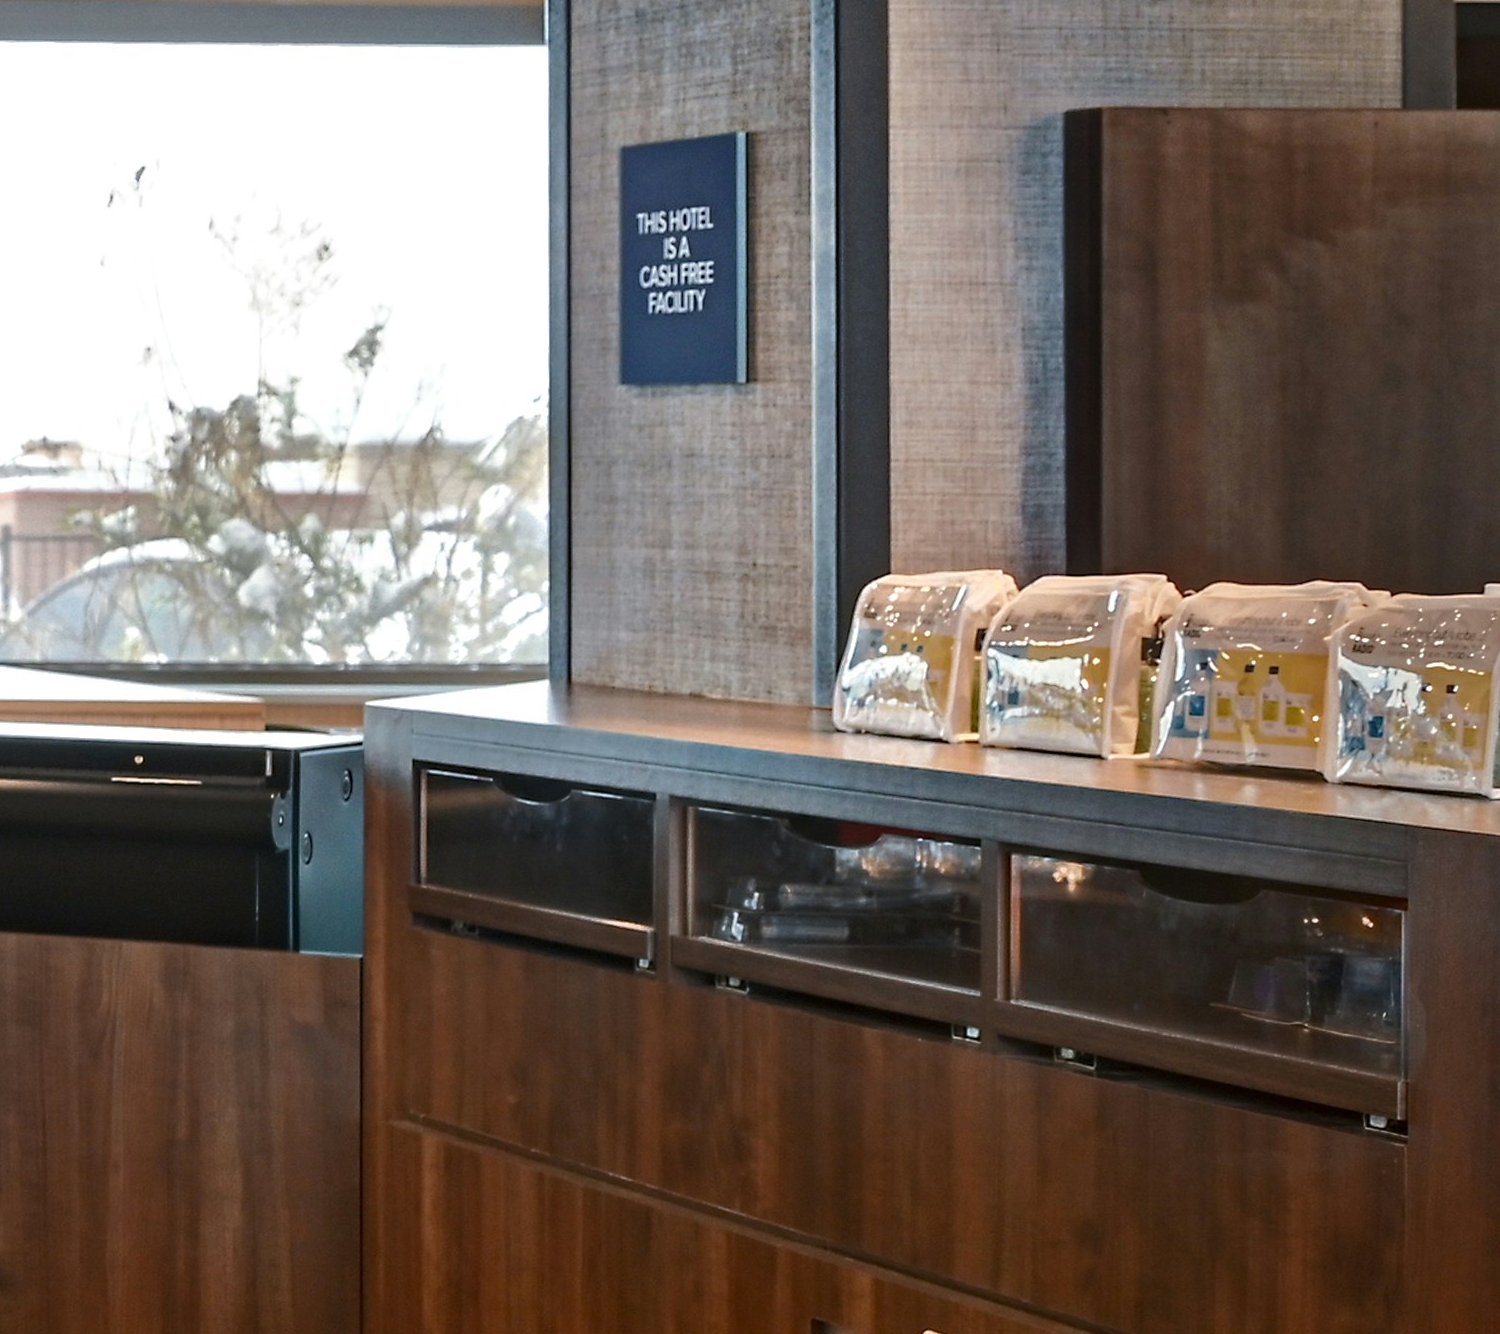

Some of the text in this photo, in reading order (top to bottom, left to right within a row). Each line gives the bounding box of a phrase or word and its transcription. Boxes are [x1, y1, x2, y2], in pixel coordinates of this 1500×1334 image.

[636, 206, 714, 235] THIS HOTEL
[663, 235, 691, 260] IS A
[639, 260, 714, 289] CASH FREE
[647, 288, 706, 315] FACILITY
